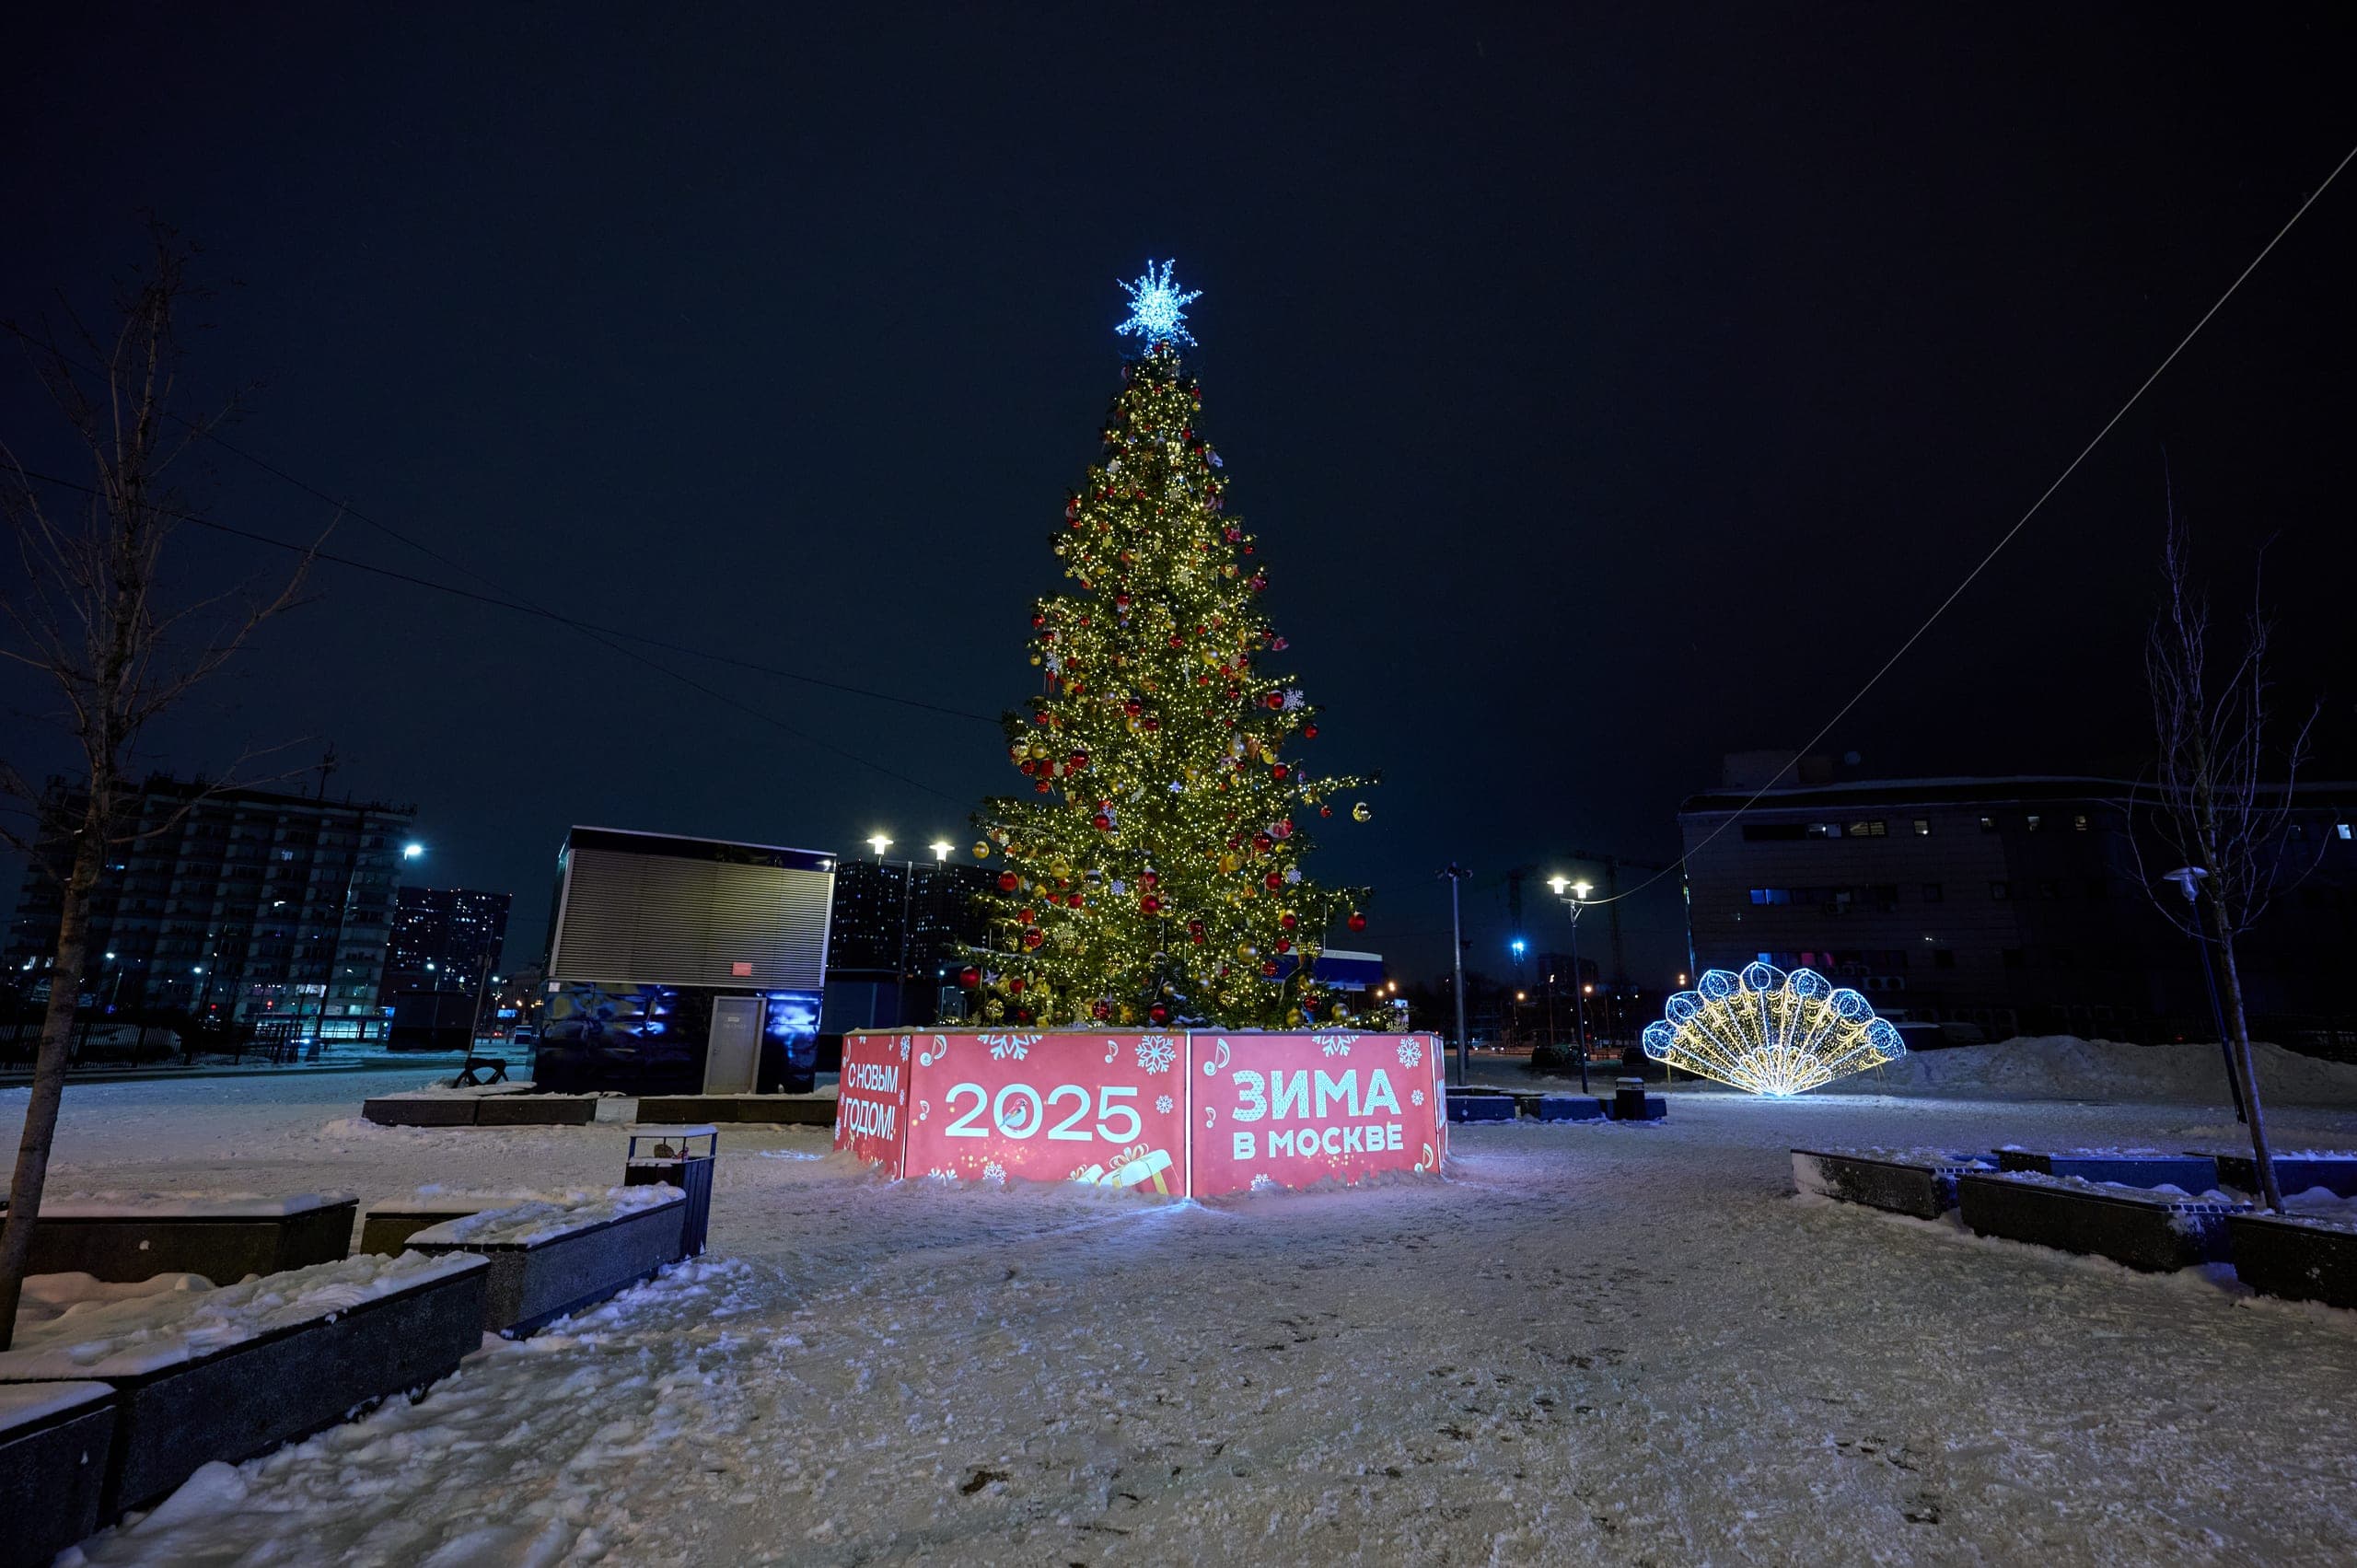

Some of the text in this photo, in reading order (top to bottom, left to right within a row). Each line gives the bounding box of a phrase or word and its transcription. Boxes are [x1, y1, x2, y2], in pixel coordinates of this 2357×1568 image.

[848, 1063, 899, 1094] С НОВЫМ
[1232, 1069, 1402, 1121] ЗИМА
[843, 1098, 896, 1141] ГОДОМ!
[945, 1083, 1142, 1144] 2025
[1233, 1124, 1404, 1160] В МОСКВЕ
